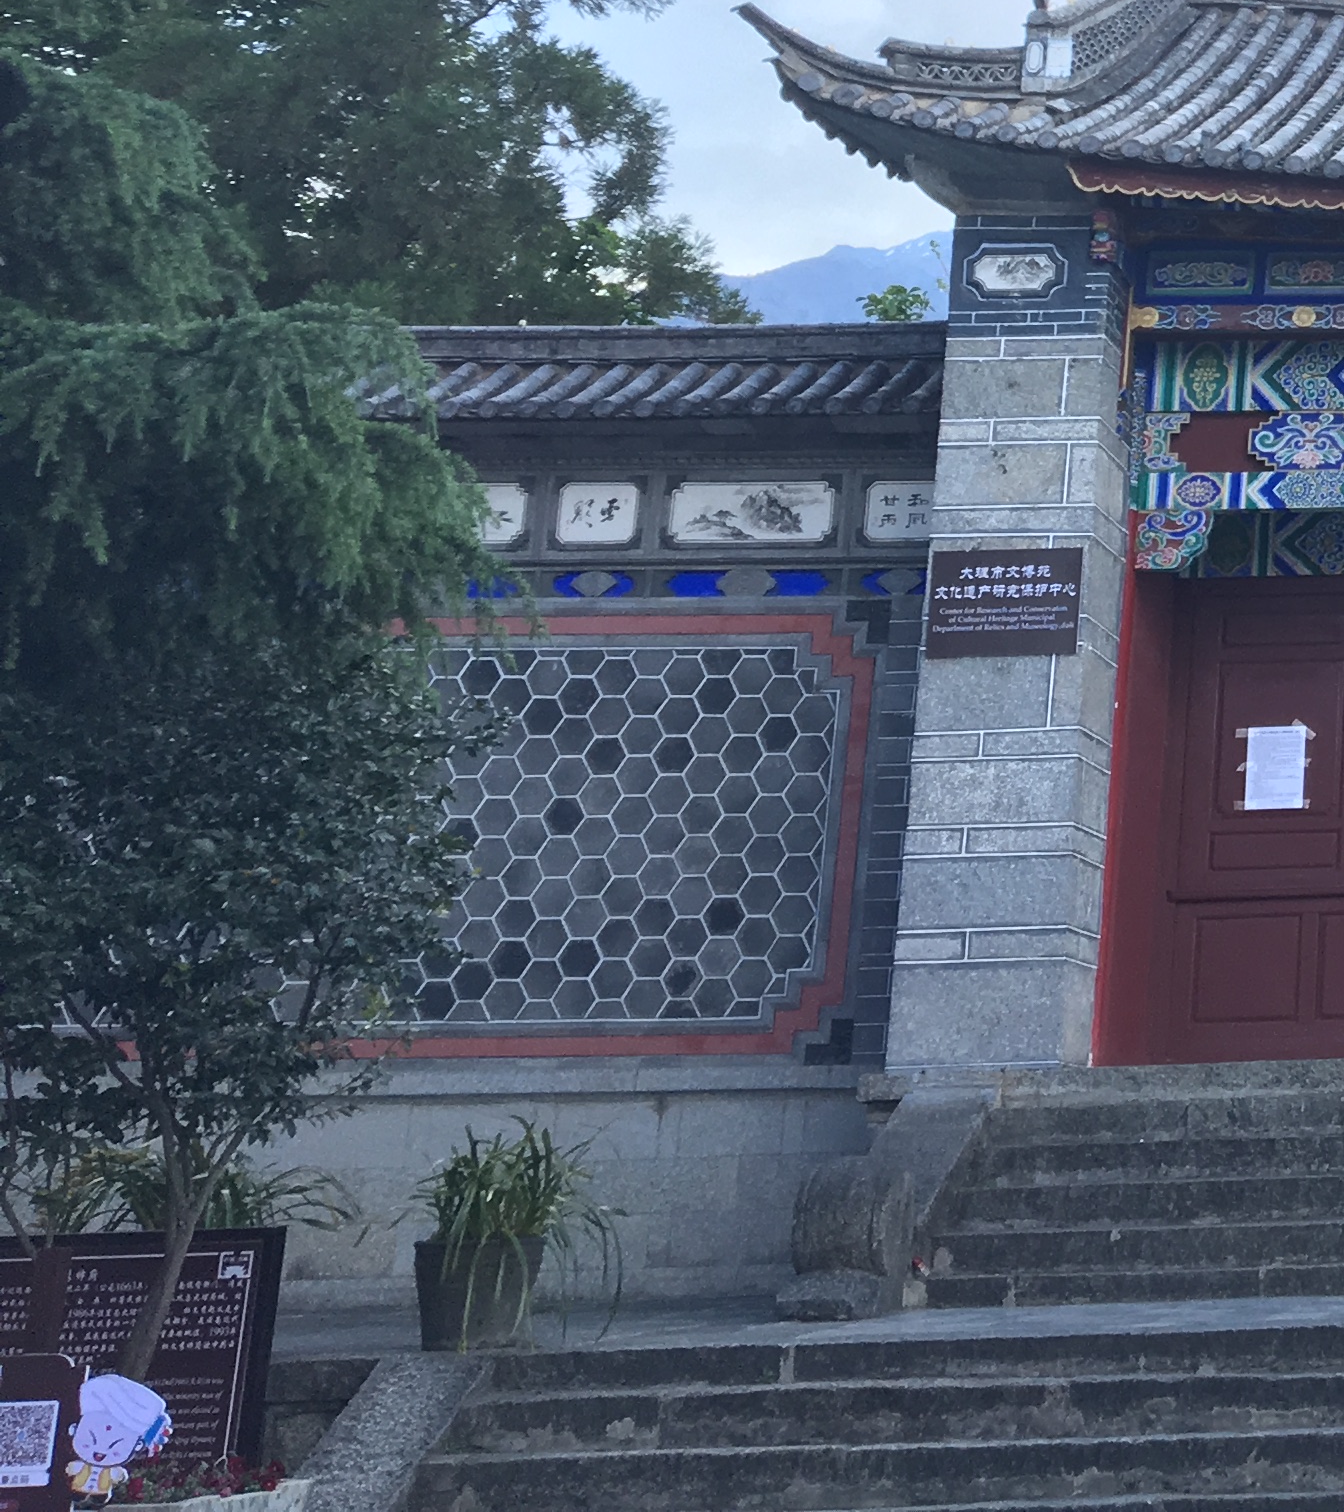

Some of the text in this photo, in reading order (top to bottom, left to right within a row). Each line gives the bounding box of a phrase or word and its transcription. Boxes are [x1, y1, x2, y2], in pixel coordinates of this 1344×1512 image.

[934, 582, 1077, 600] 文化遗产研究保护中心
[939, 607, 963, 615] Center
[976, 606, 1008, 614] Research
[1009, 605, 1022, 613] and
[948, 613, 1056, 624] of Cultural Heritage Municipal
[932, 624, 974, 633] Department
[1005, 622, 1019, 630] and
